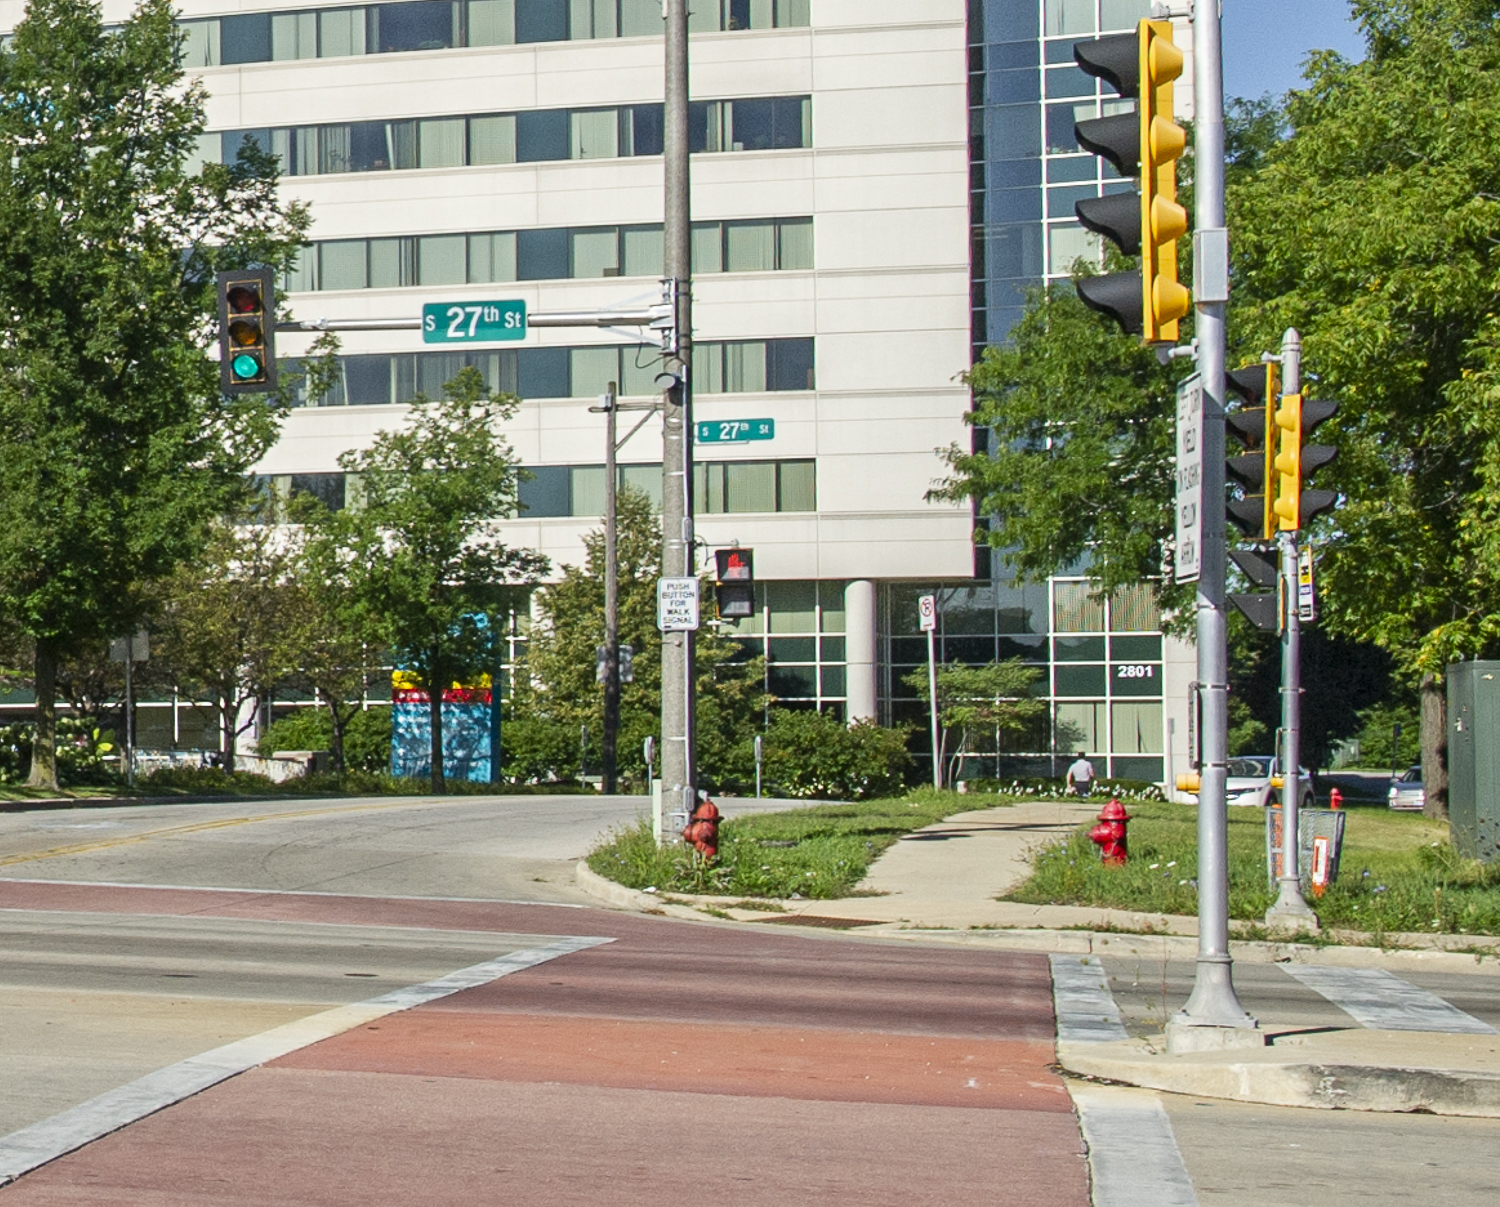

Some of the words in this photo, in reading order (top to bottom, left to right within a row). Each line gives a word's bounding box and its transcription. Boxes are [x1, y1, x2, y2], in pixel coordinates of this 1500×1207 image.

[425, 314, 436, 331] S
[446, 305, 499, 338] 27th
[504, 311, 521, 328] St
[702, 426, 709, 437] S
[719, 422, 749, 440] 27th
[759, 424, 769, 435] St
[666, 583, 690, 591] PUSH
[661, 591, 695, 599] BUTTON
[670, 599, 686, 607] FOR
[1117, 665, 1154, 678] 2801
